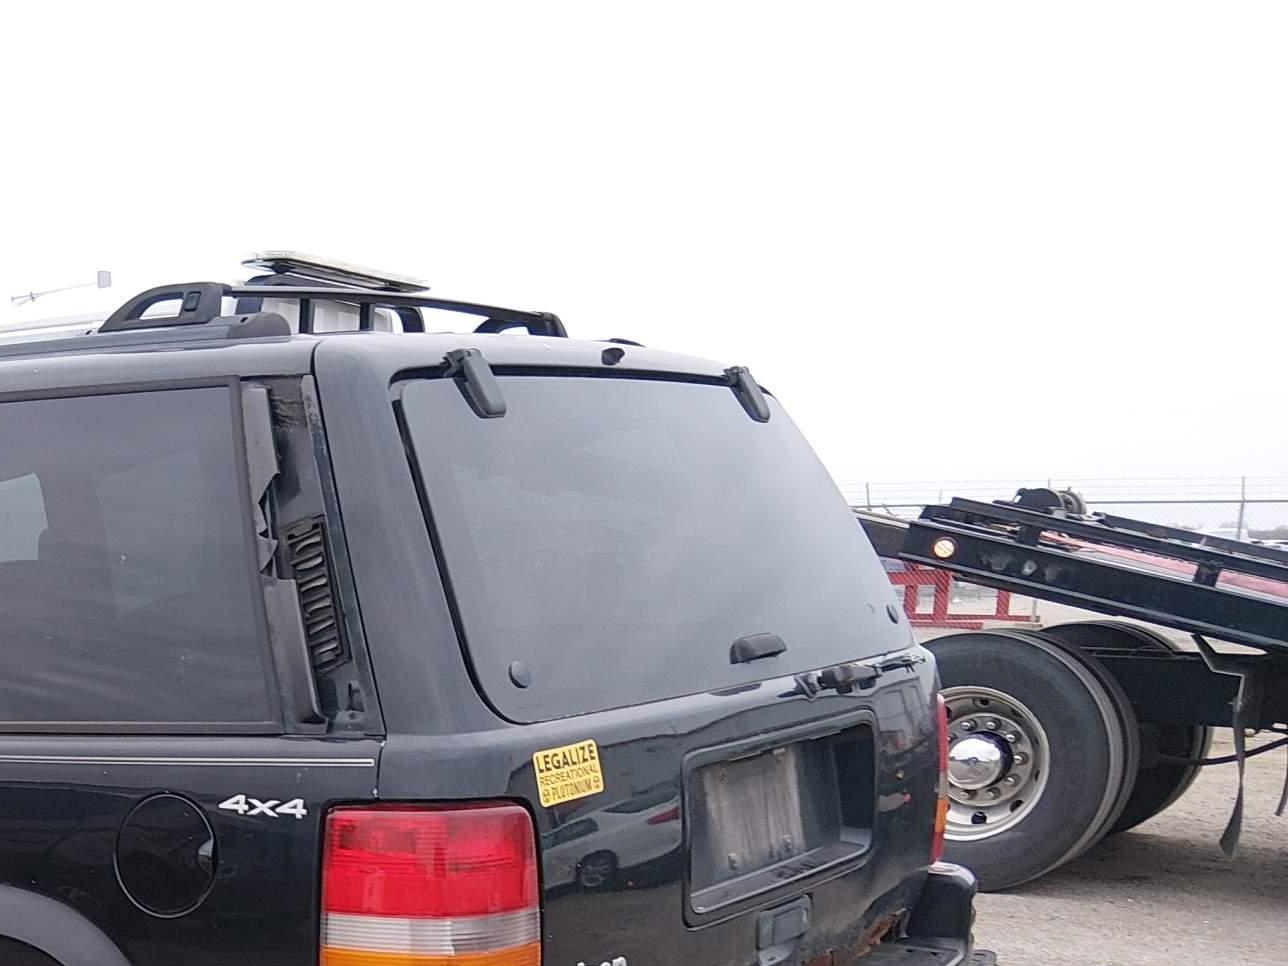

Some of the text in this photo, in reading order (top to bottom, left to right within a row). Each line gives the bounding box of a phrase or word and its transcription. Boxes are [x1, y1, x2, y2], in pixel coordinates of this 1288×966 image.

[535, 743, 596, 773] LEGALIZE
[539, 763, 599, 786] RECREATIONAL
[551, 778, 593, 800] PLUTONIUM
